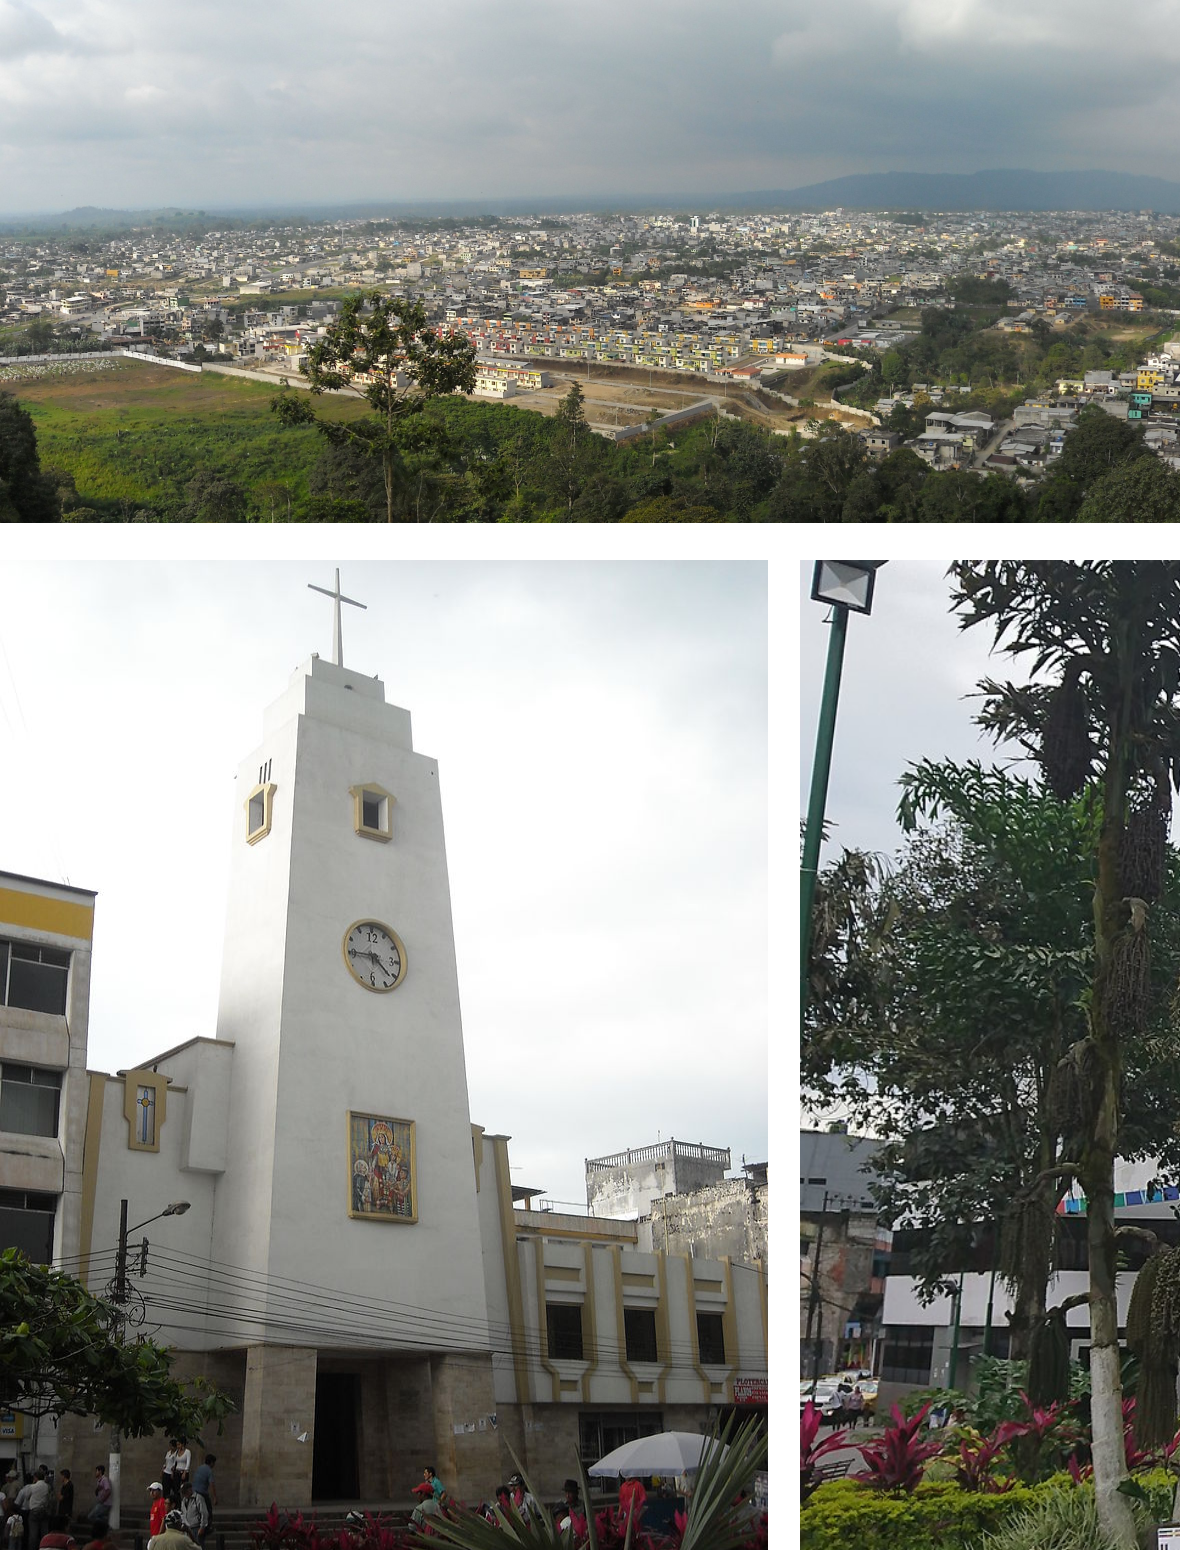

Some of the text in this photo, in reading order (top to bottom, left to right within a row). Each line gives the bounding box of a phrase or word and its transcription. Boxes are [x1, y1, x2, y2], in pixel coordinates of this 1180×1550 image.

[366, 932, 378, 944] 12
[389, 957, 395, 967] 3
[370, 972, 376, 982] 6
